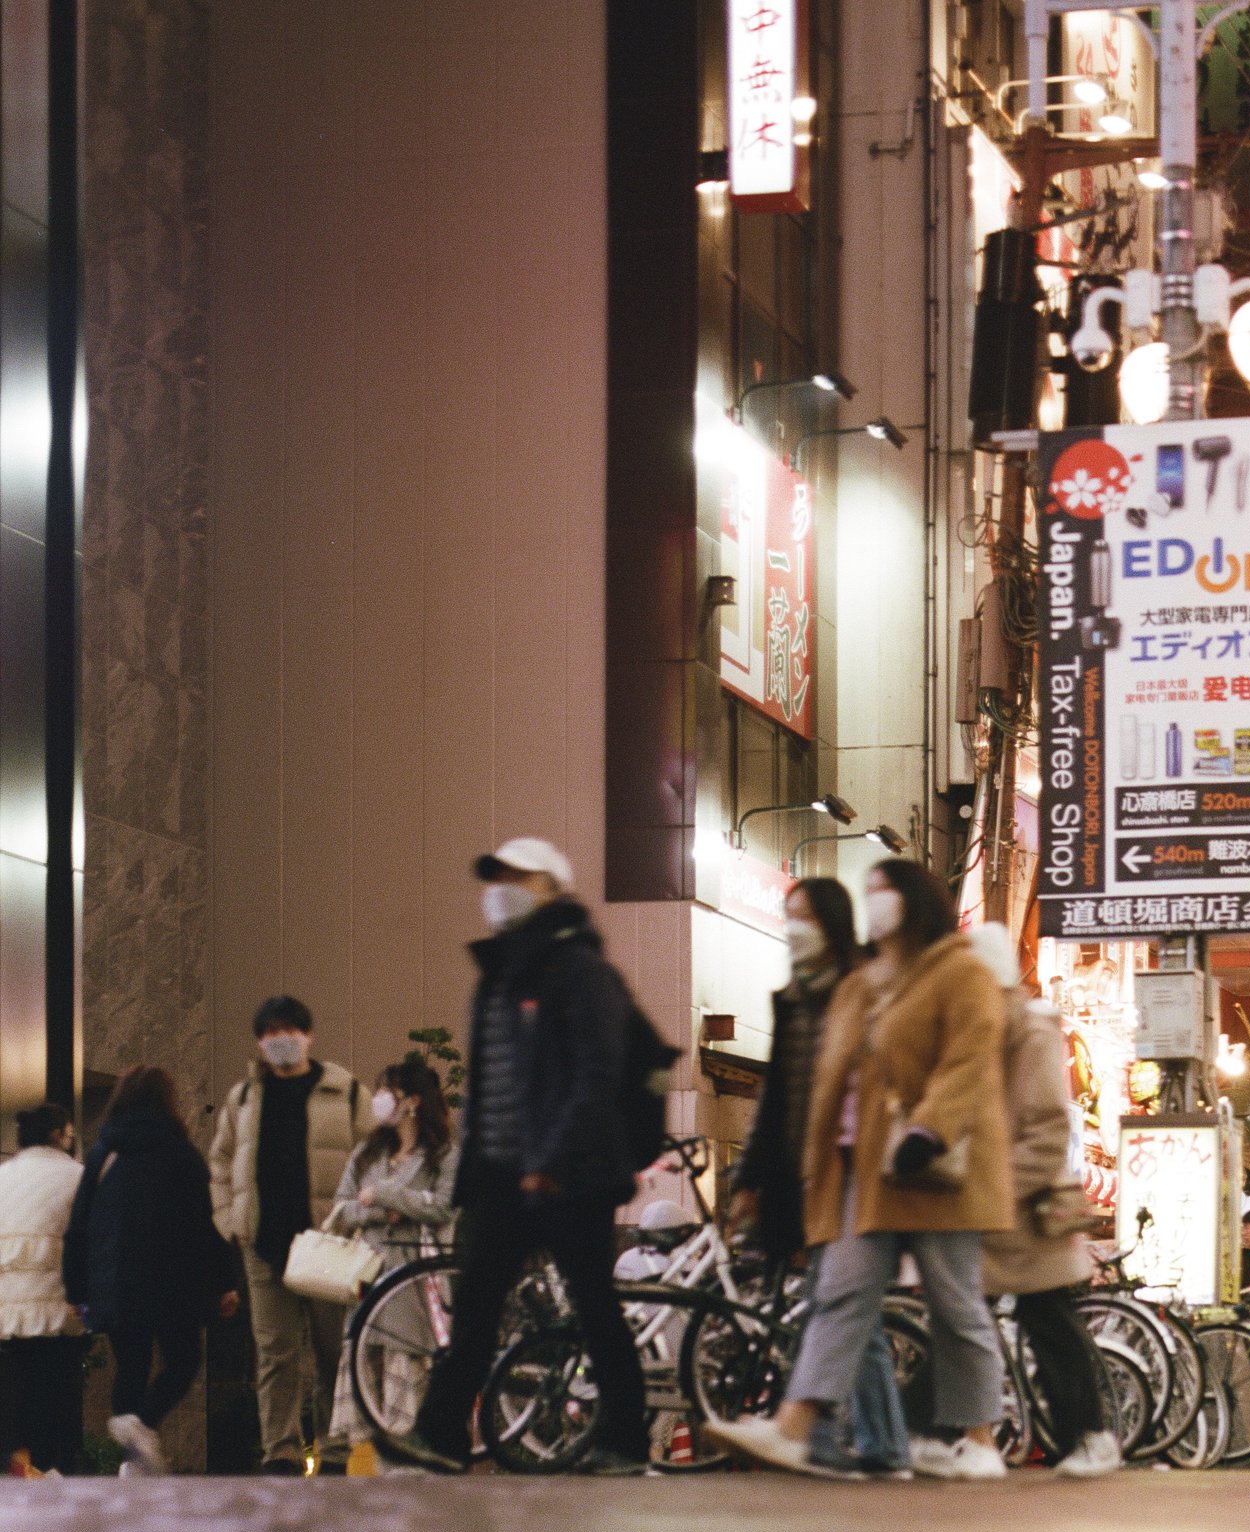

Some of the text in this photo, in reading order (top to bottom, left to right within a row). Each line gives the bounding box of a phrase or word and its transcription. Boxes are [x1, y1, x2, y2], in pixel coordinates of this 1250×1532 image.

[767, 549, 792, 722] 一蘭
[1043, 520, 1083, 888] Japan. Tax-free Shop
[1120, 788, 1197, 812] 心斎橋店
[1153, 846, 1206, 864] 540m
